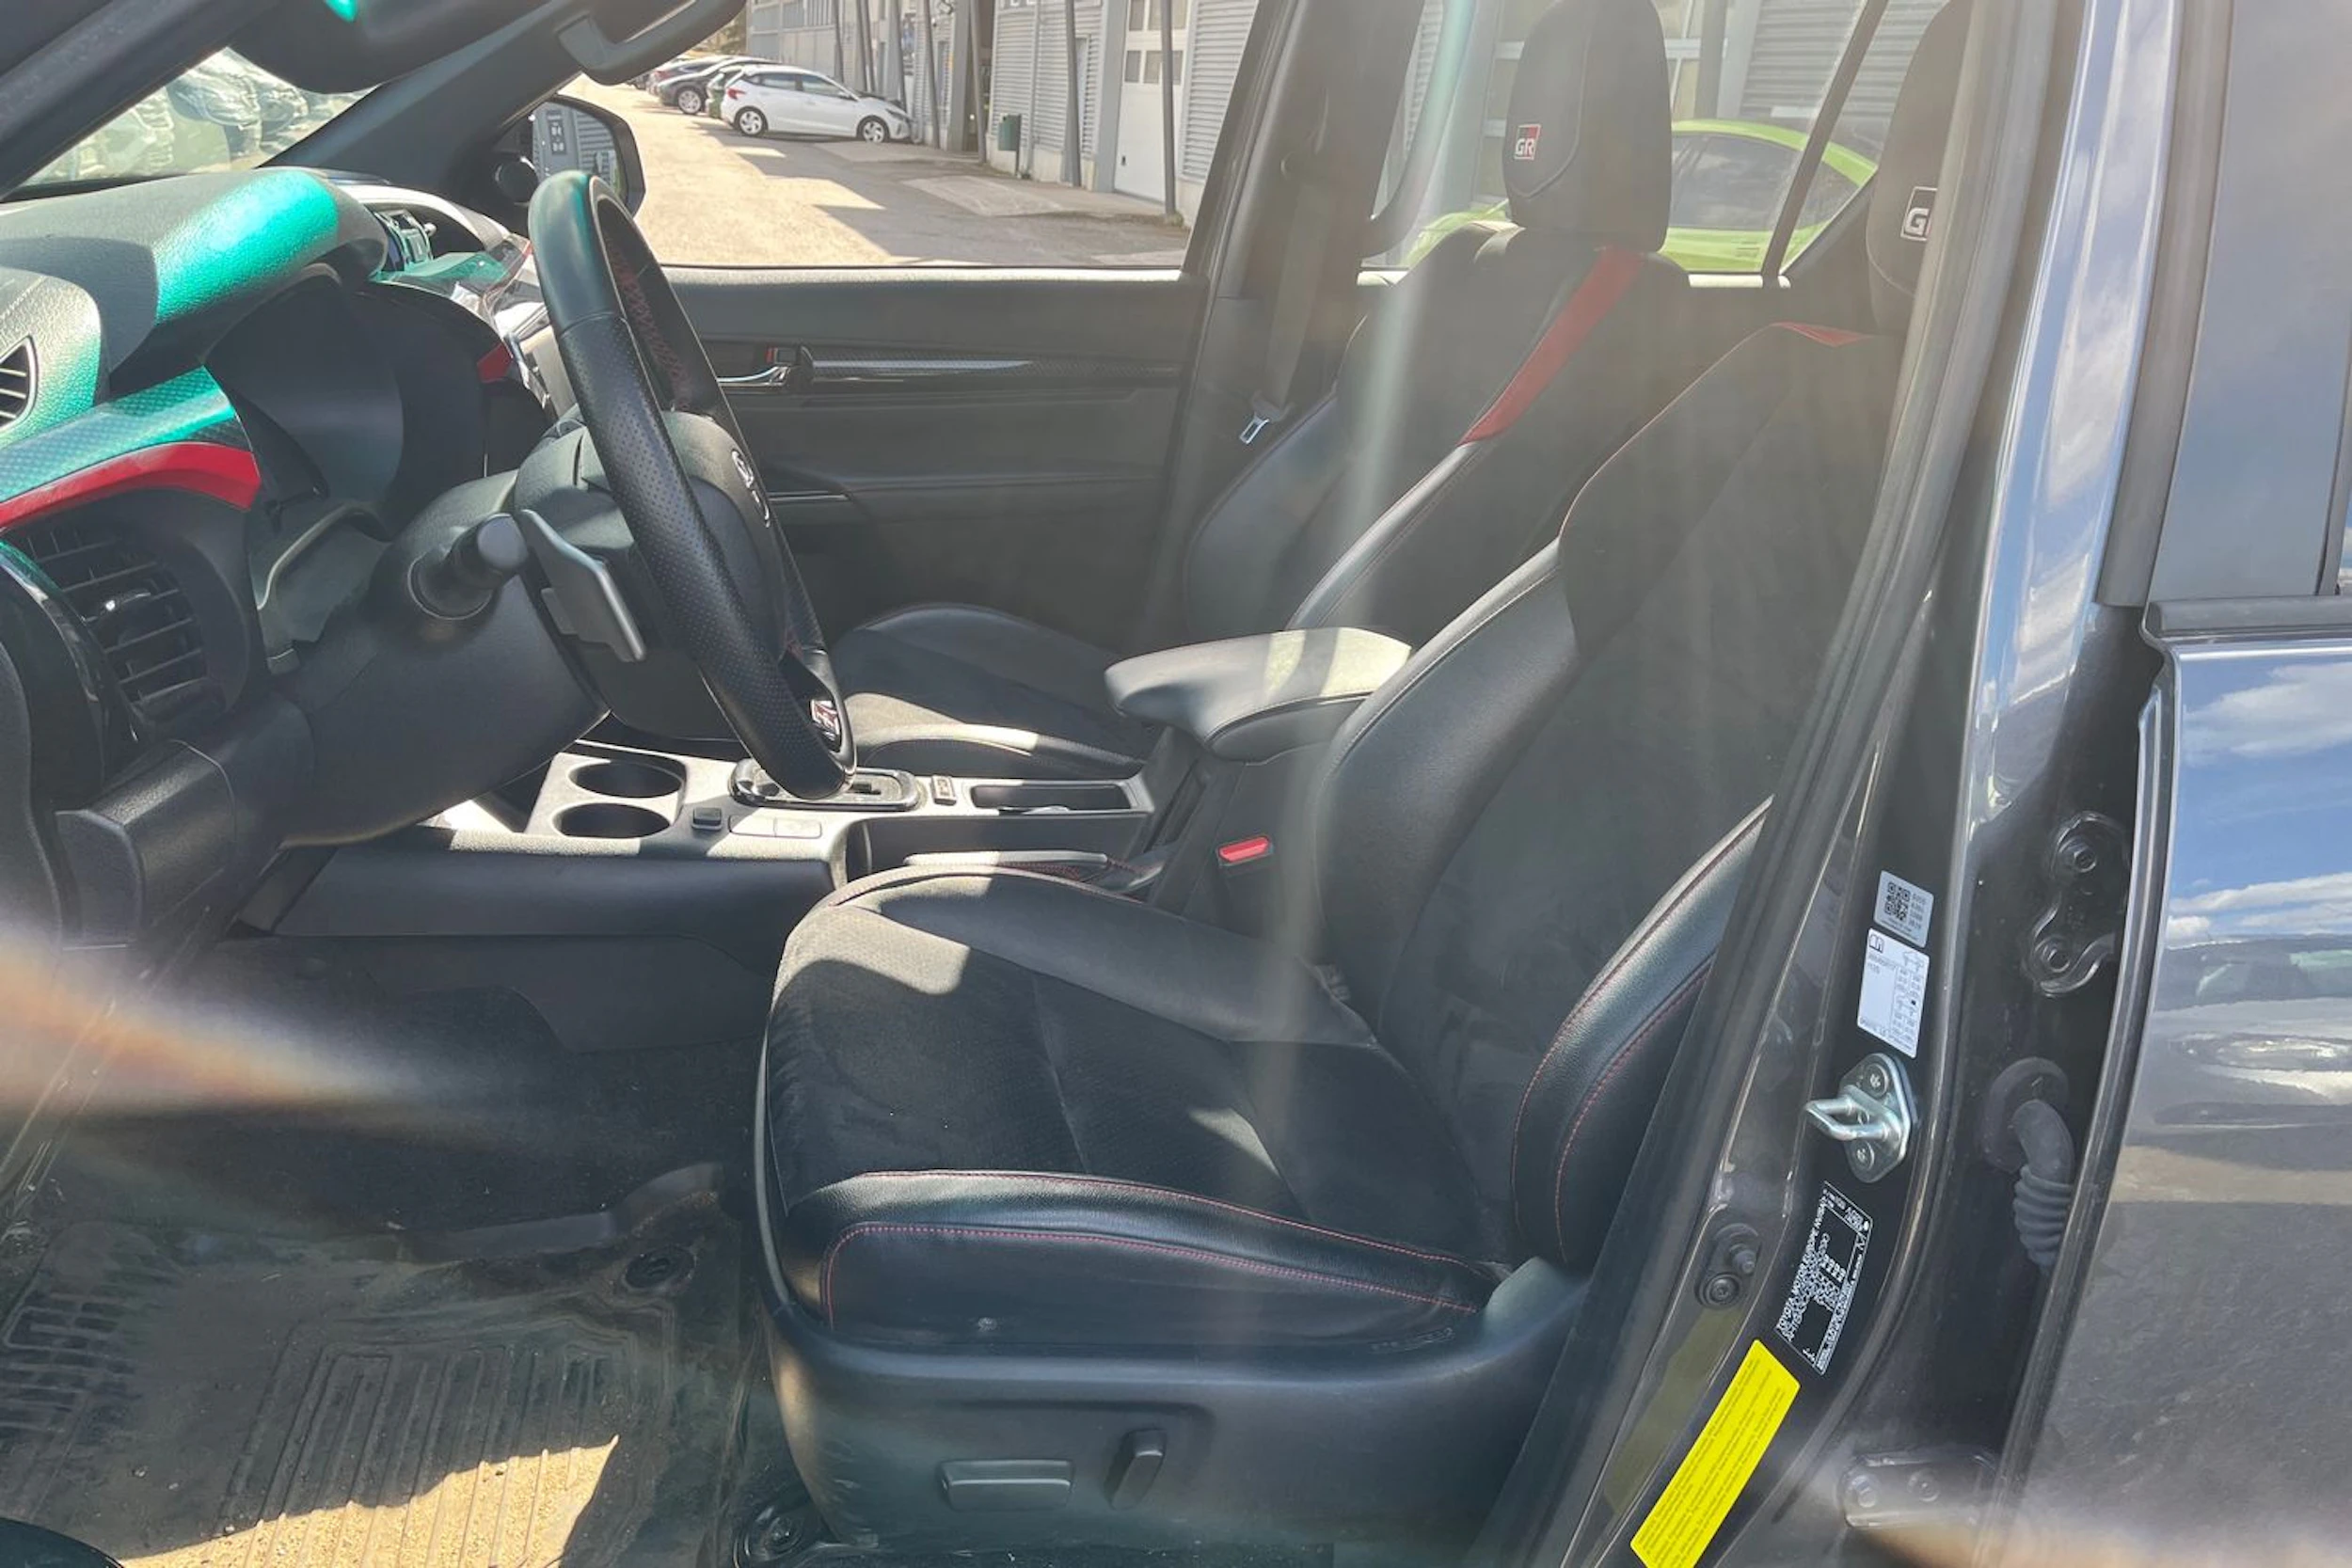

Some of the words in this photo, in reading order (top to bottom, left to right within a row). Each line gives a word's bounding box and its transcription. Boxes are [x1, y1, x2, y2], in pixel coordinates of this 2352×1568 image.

[1516, 137, 1535, 155] GR
[1905, 207, 1931, 236] G
[1777, 1296, 1794, 1330] TOYOTA
[1791, 1264, 1806, 1296] MOTOR
